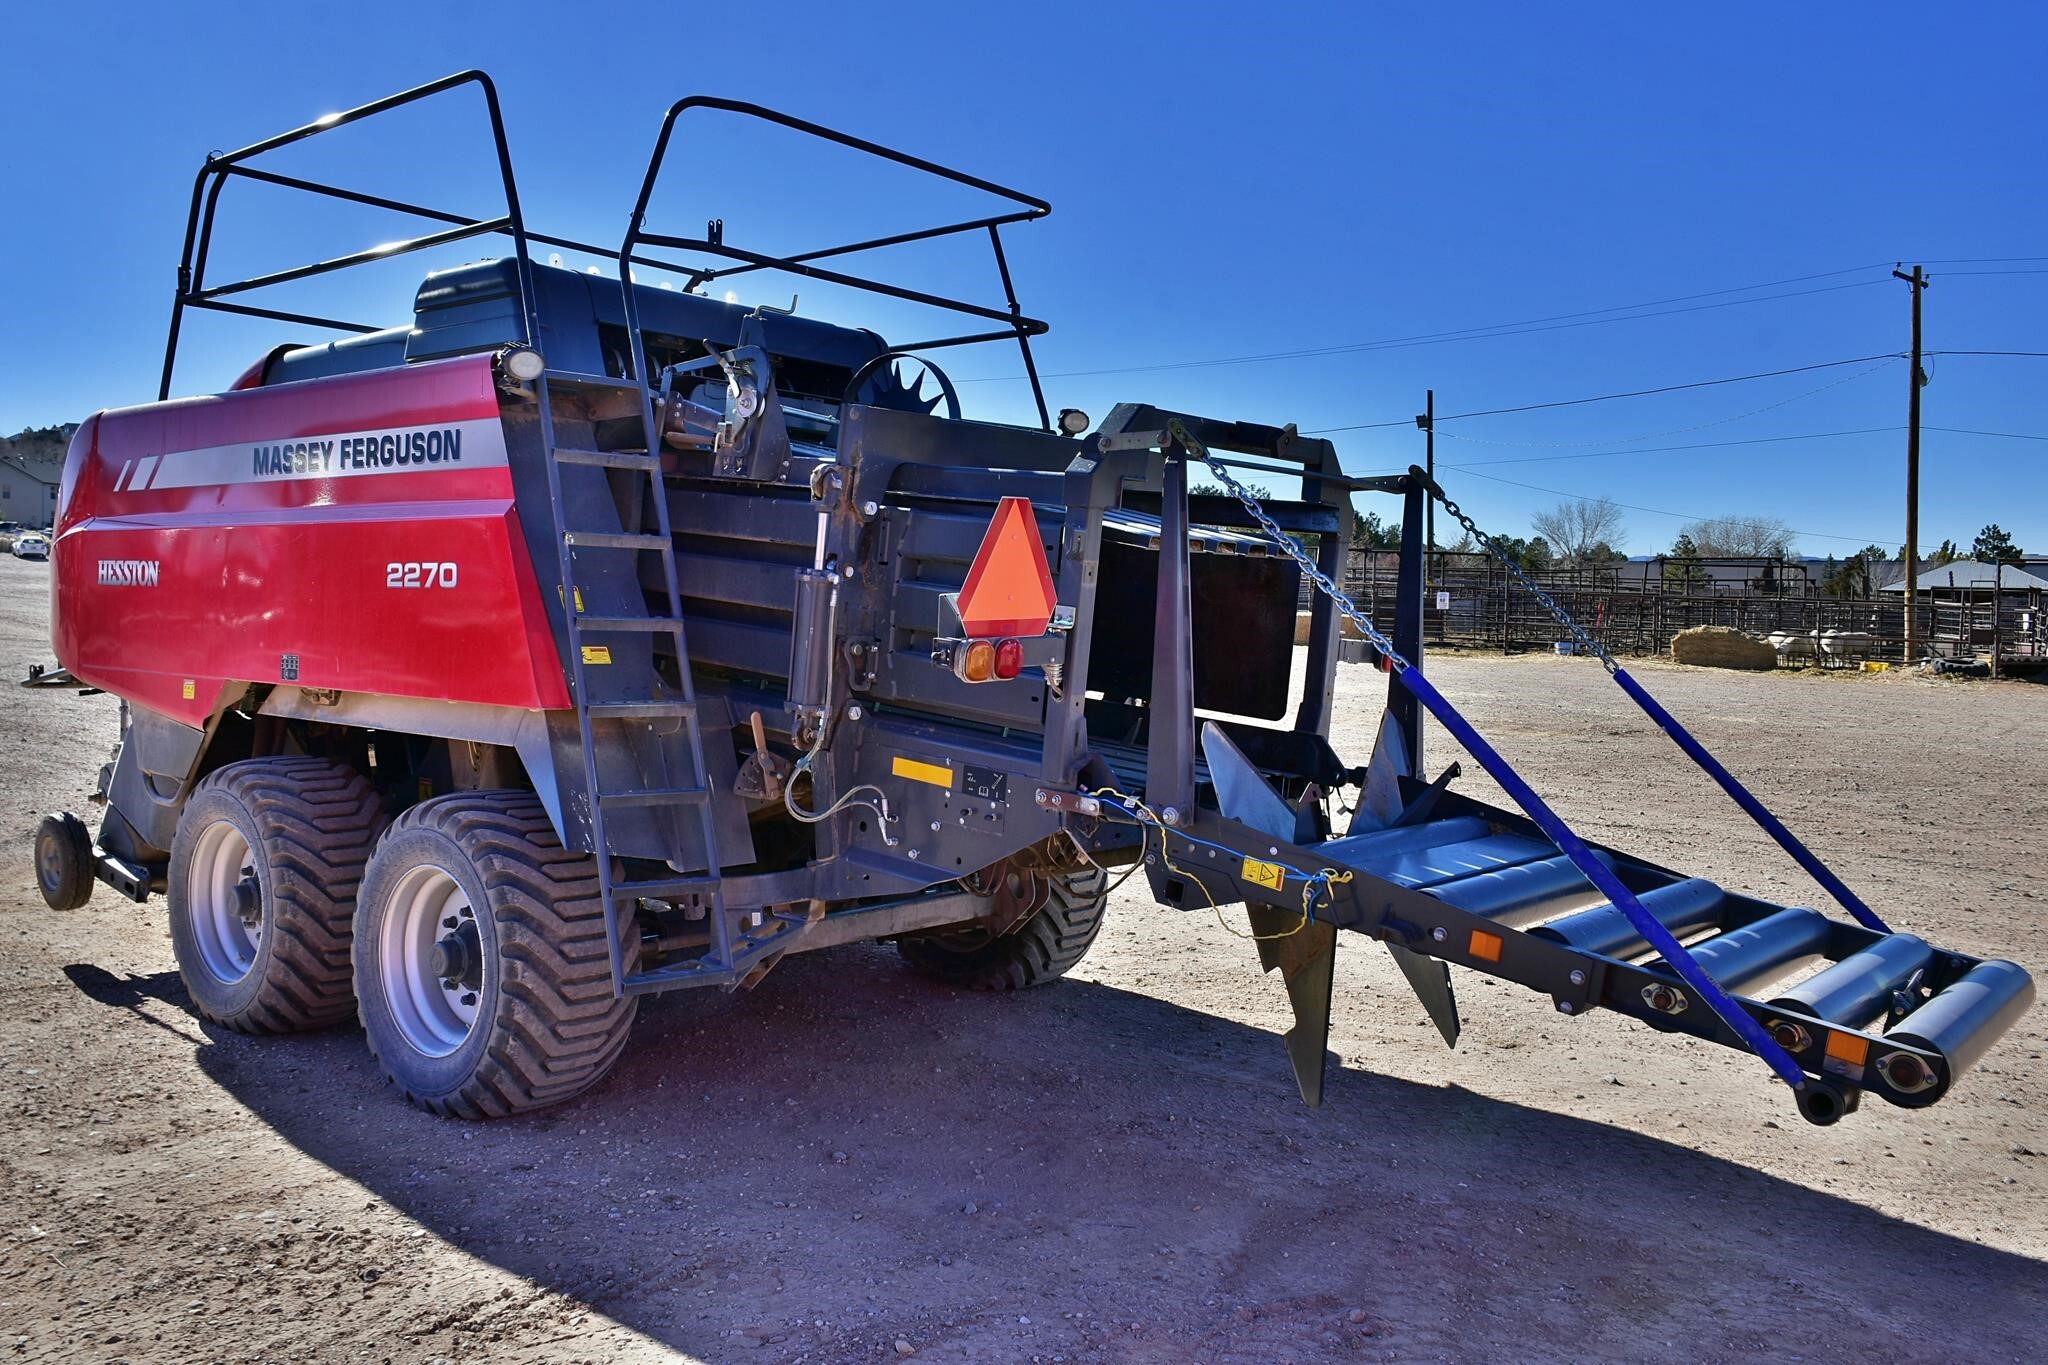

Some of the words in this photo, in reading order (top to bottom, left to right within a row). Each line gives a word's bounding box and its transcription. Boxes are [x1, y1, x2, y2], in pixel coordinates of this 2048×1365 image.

[253, 440, 334, 477] MASSEY
[340, 428, 462, 470] FERGUSON
[97, 560, 160, 588] HESSTON
[386, 562, 458, 588] 2270
